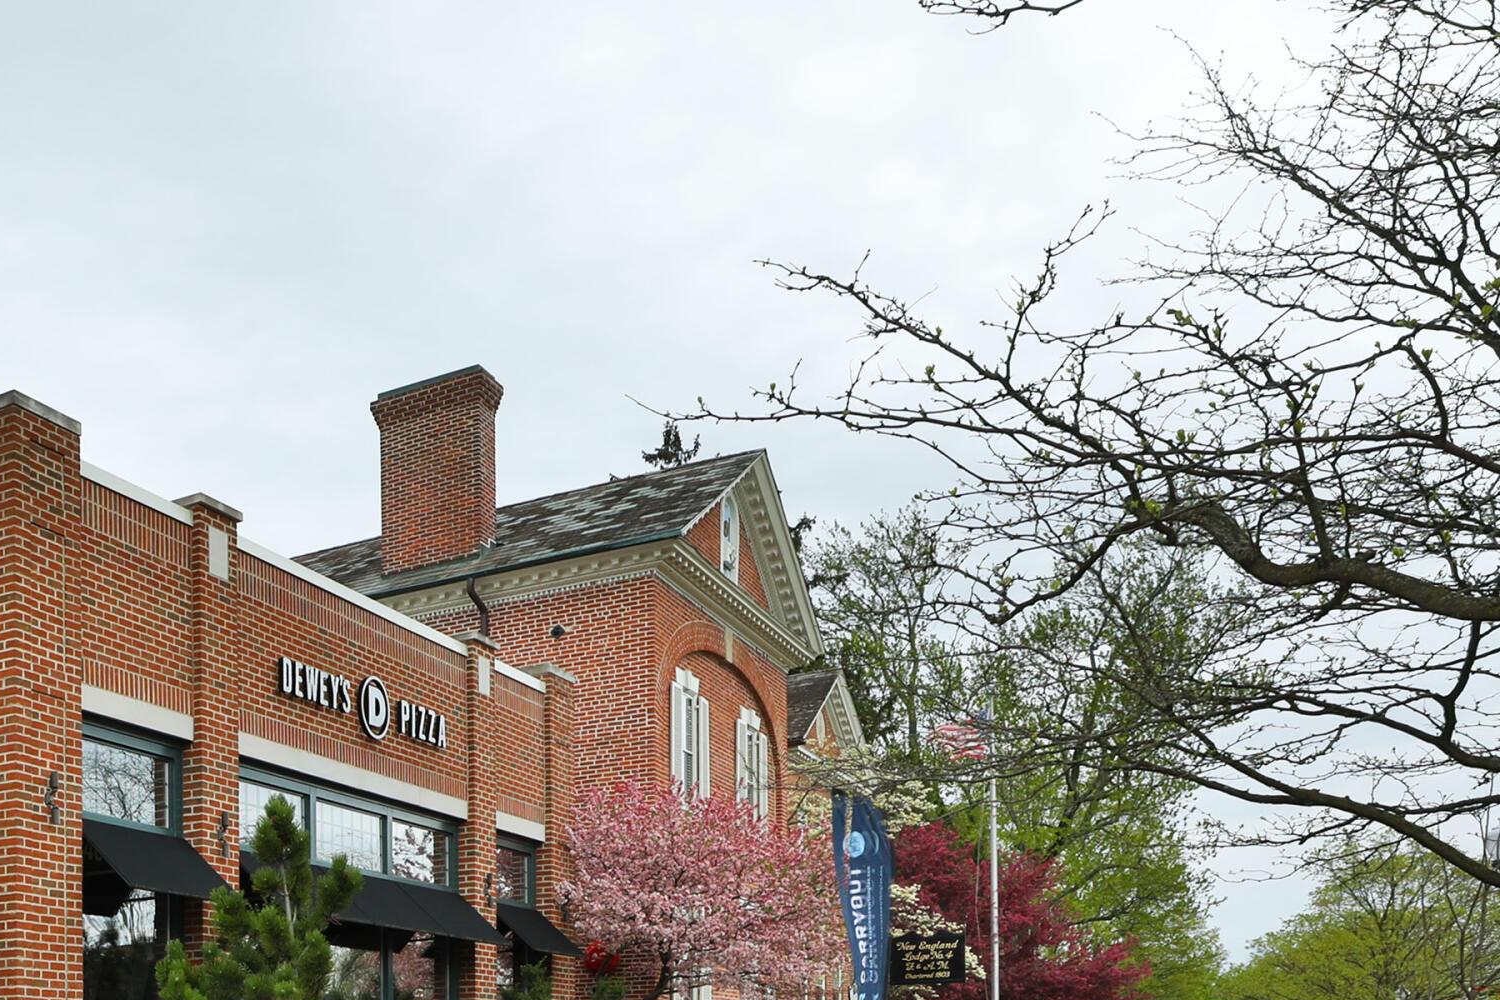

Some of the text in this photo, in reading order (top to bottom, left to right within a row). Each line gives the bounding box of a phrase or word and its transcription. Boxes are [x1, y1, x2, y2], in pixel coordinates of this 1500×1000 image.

[280, 656, 447, 749] DEWEY'S D PIZZA
[896, 939, 959, 952] New England
[902, 951, 930, 962] Lodge
[945, 950, 954, 959] 4
[904, 972, 934, 980] Chartered
